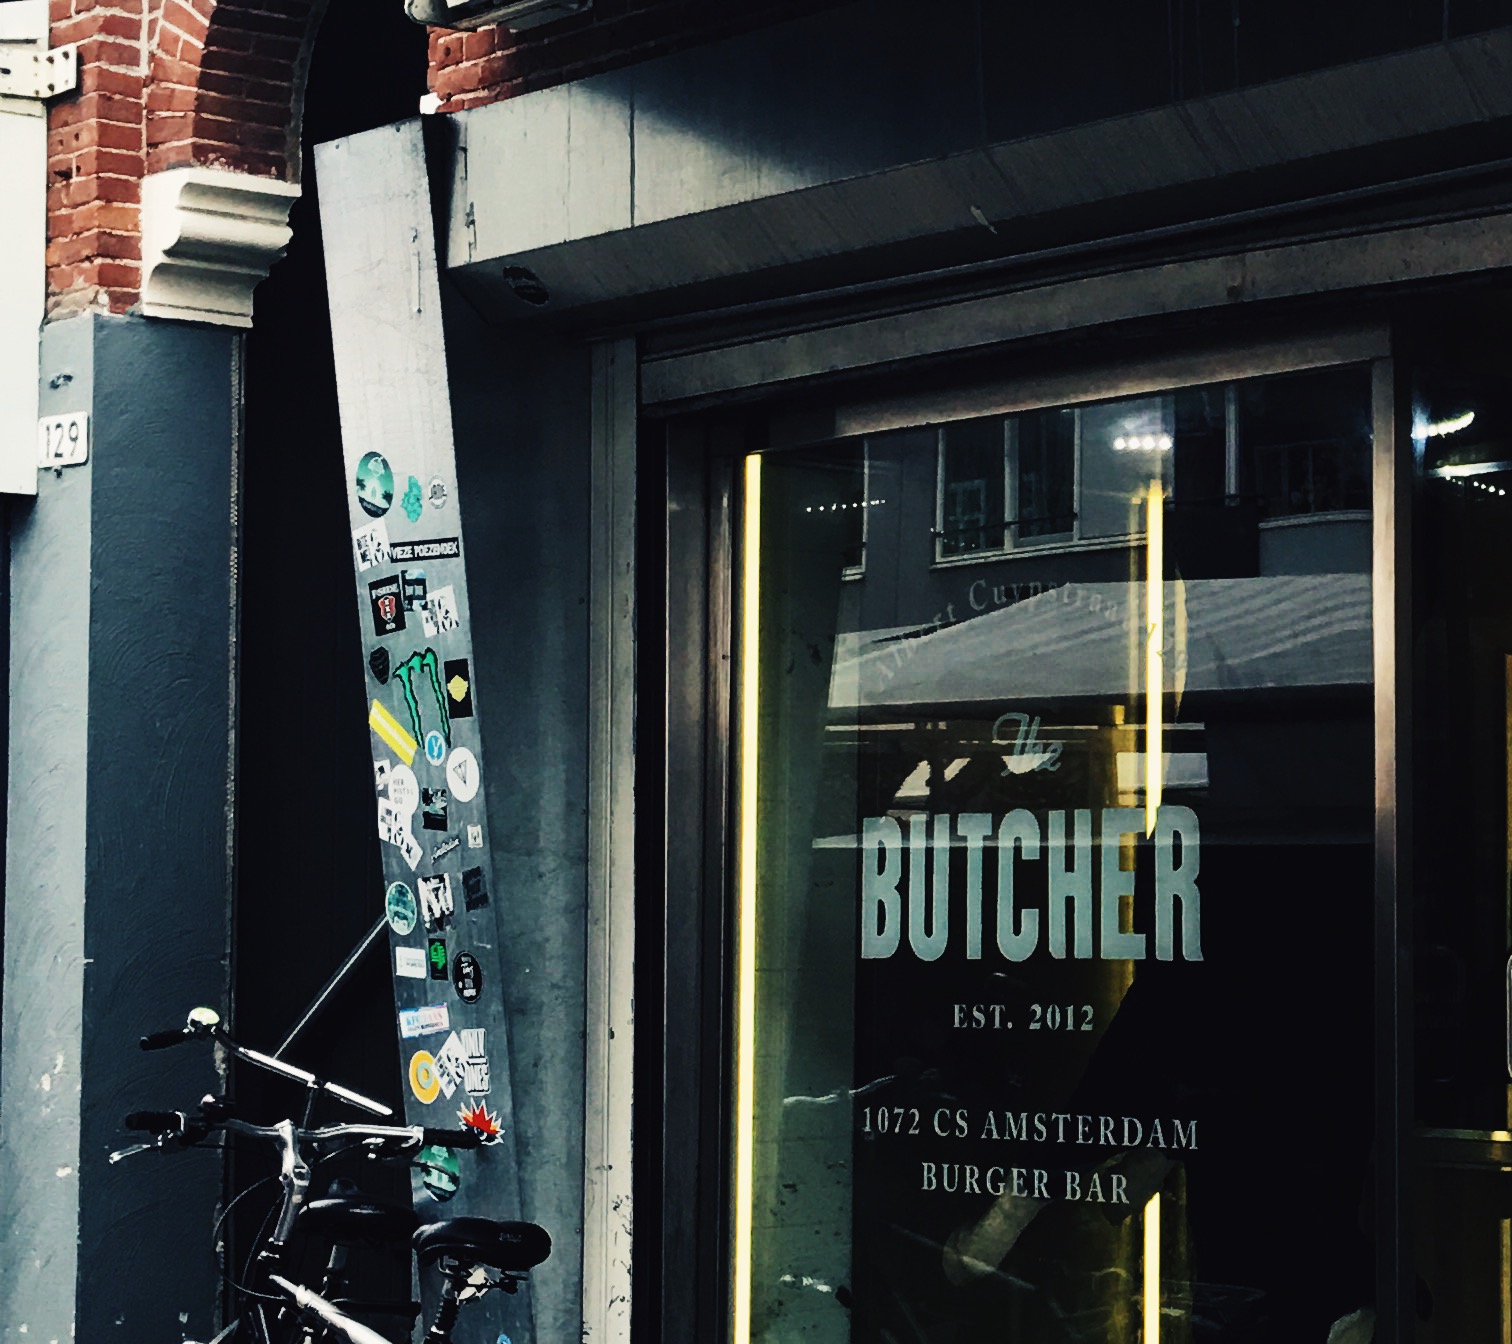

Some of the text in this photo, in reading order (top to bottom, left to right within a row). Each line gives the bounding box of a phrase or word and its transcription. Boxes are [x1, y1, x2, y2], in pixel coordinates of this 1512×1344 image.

[44, 421, 80, 459] 129
[993, 712, 1063, 776] The
[861, 805, 1204, 962] BUTCHER
[953, 1003, 1095, 1031] EST. 2012
[862, 1106, 1199, 1150] 1072 CS AMSTERDAM
[921, 1161, 1130, 1205] BURGER BAR
